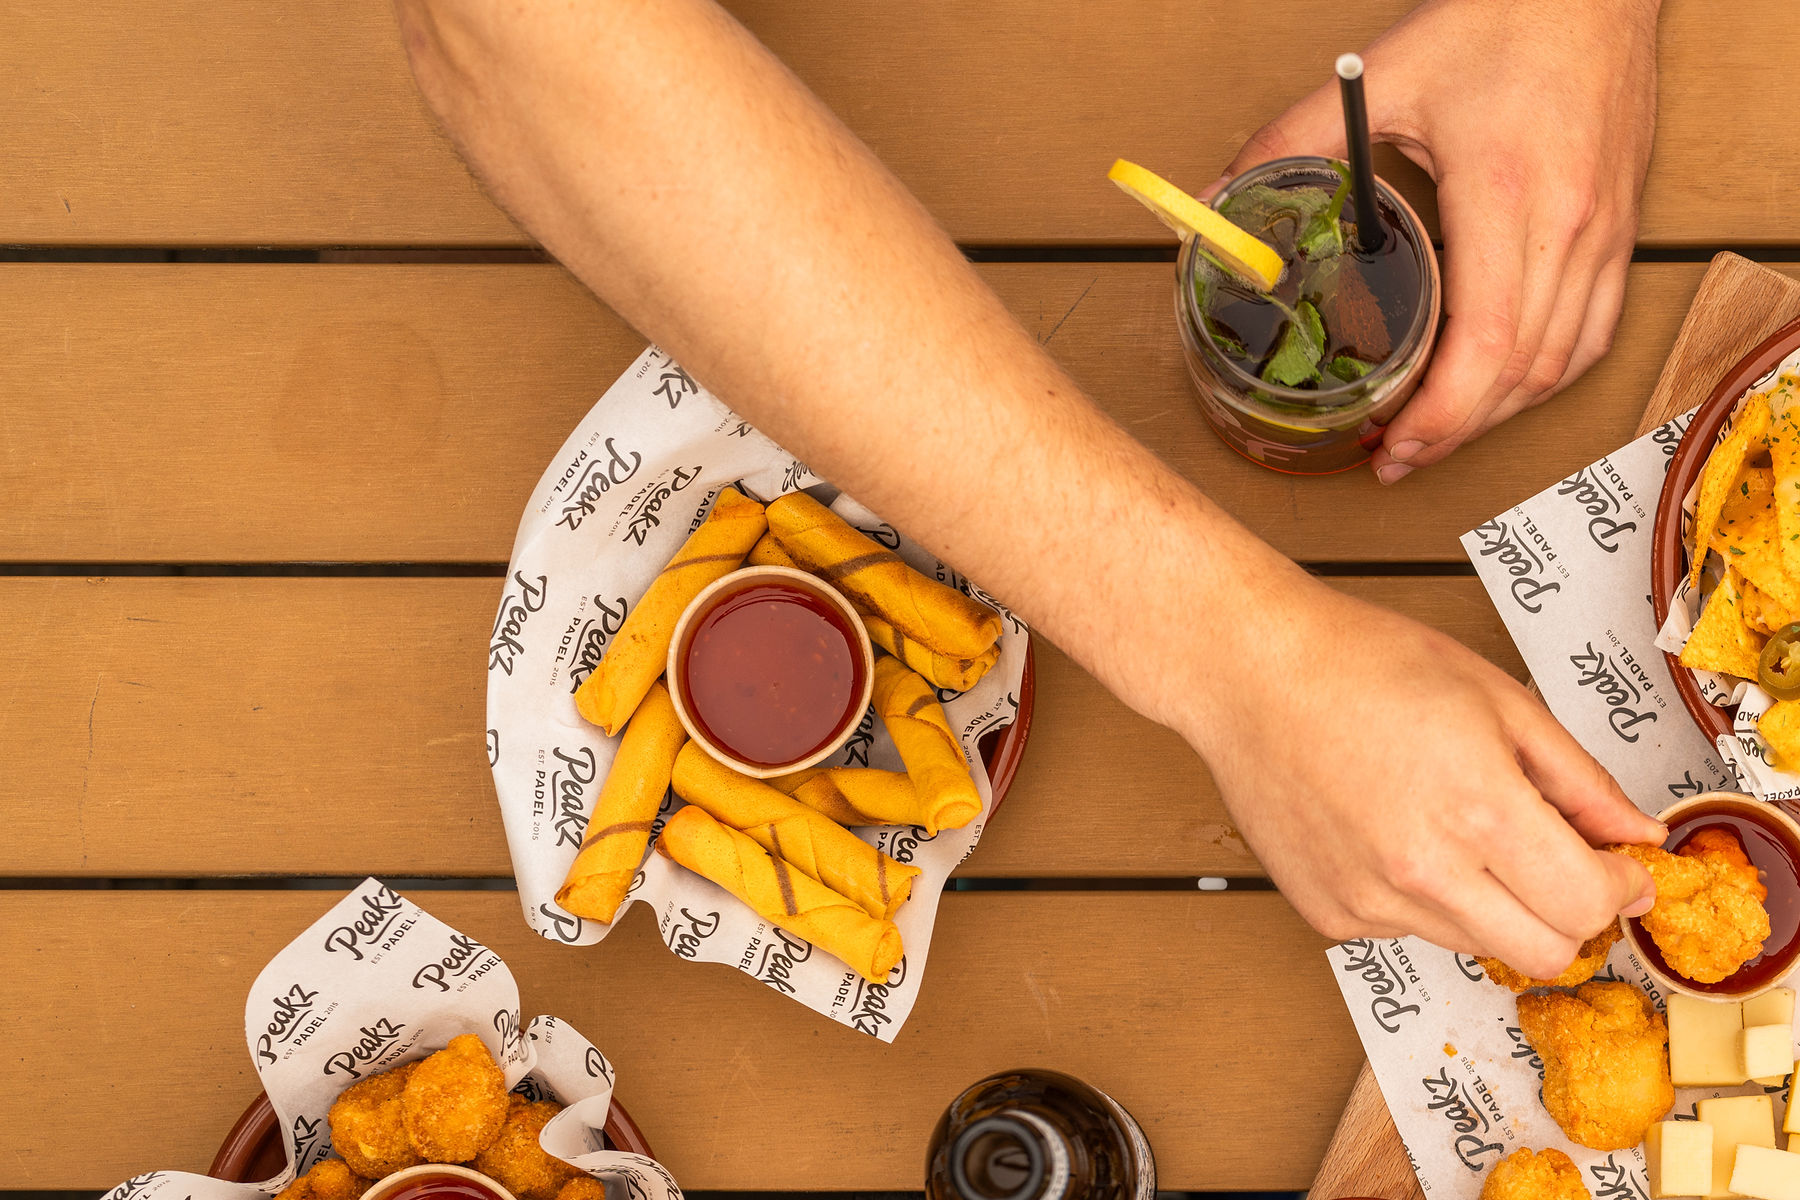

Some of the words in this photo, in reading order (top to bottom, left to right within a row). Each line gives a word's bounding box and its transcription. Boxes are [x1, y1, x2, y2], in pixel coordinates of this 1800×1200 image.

[553, 450, 588, 494] PADEL
[555, 437, 642, 530] Peakz
[1600, 456, 1635, 503] PADEL
[619, 482, 655, 517] PADEL
[622, 465, 702, 546] Peakz
[1522, 516, 1559, 563] PADEL
[1474, 519, 1561, 614] Peakz
[489, 570, 548, 676] Peakz
[554, 617, 582, 663] PADEL
[1569, 641, 1658, 743] Peakz
[1619, 646, 1654, 692] PADEL
[532, 770, 546, 817] PADEL
[553, 746, 596, 849] Peakz
[324, 884, 402, 961] Peakz
[383, 918, 416, 952] PADEL
[468, 954, 502, 982] PADEL
[738, 937, 761, 971] PADEL
[1389, 938, 1421, 984] PADEL
[832, 972, 855, 1010] PADEL
[1340, 938, 1421, 1033] Peakz
[258, 983, 319, 1072] Peakz
[294, 1016, 326, 1047] PADEL
[323, 1017, 406, 1079] Peakz
[378, 1042, 412, 1073] PADEL
[1423, 1067, 1505, 1172] Peakz
[1471, 1076, 1505, 1121] PADEL
